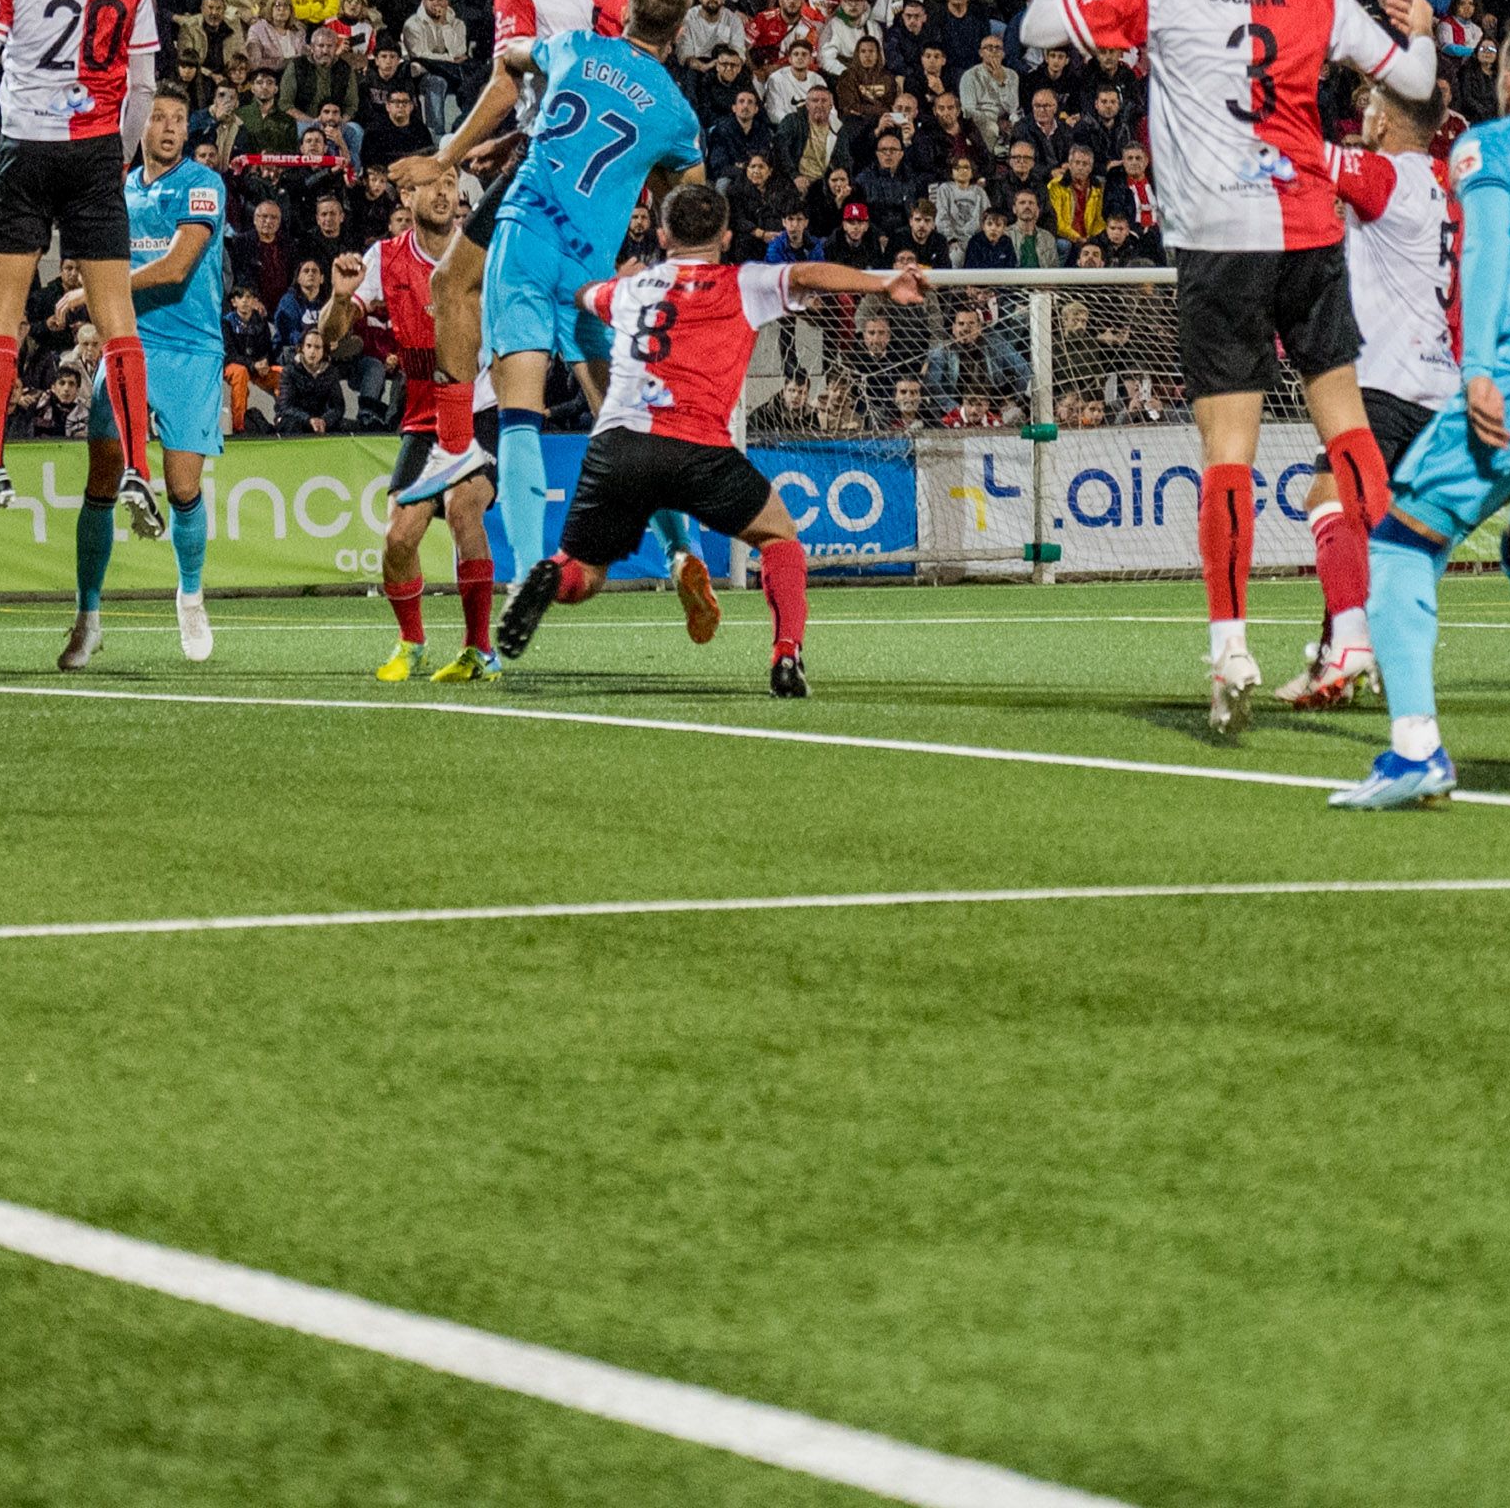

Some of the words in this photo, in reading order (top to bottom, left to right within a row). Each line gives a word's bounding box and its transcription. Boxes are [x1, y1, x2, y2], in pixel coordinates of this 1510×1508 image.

[583, 58, 656, 113] EGILUZ
[1225, 23, 1278, 124] 3
[531, 89, 640, 198] 27
[130, 236, 172, 250] xabank
[1435, 220, 1460, 311] 5
[630, 300, 679, 363] 8
[1053, 449, 1317, 529] aino
[335, 548, 384, 578] ag
